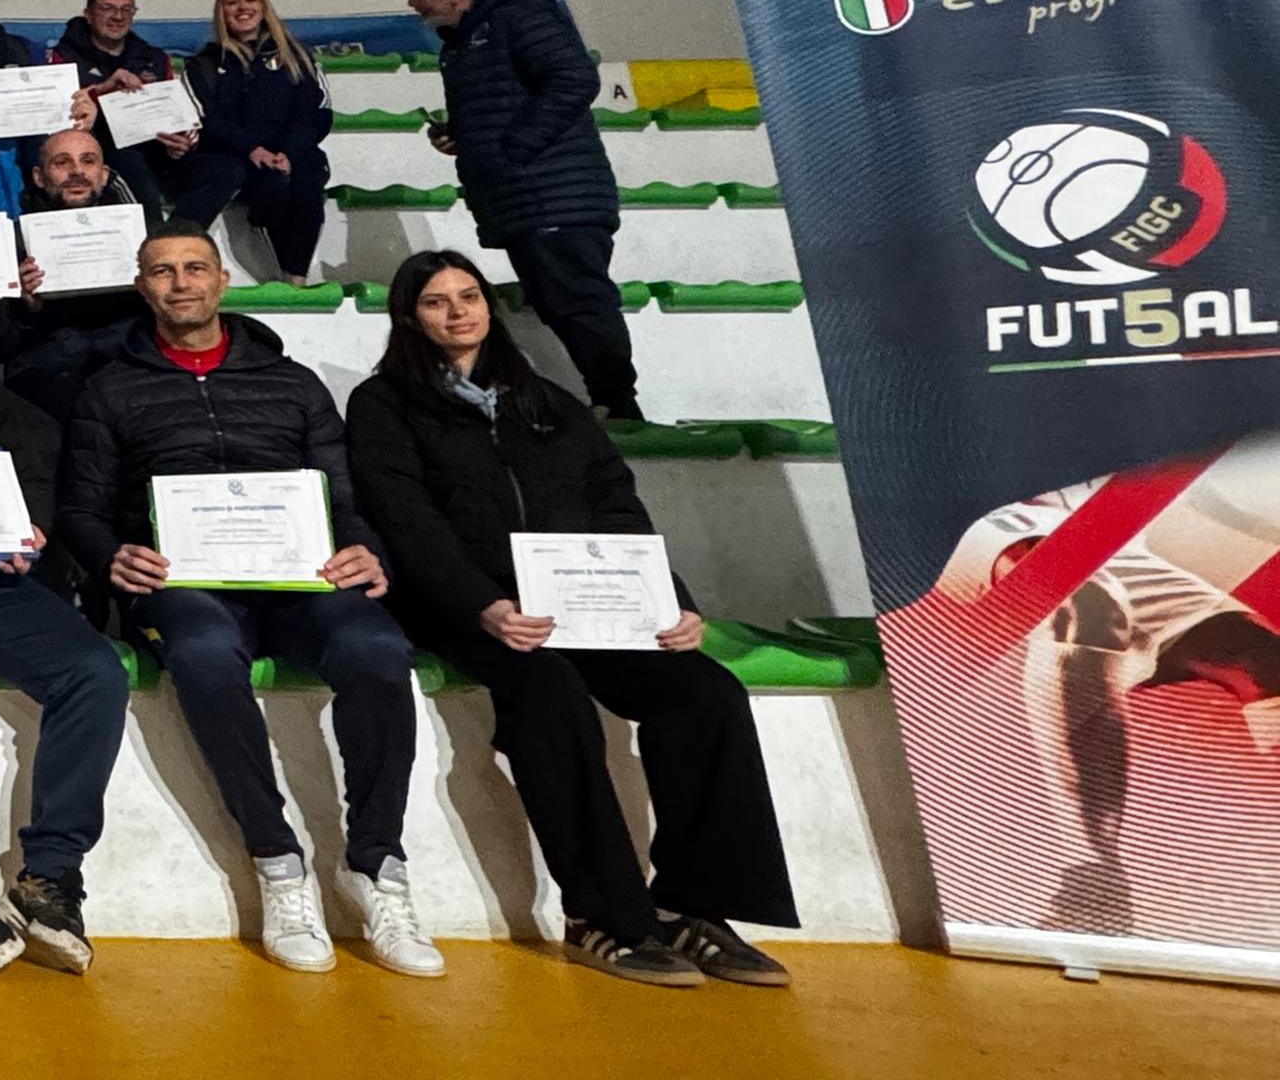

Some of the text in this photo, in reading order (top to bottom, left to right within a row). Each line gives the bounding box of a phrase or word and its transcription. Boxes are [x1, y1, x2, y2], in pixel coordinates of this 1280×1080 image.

[613, 84, 628, 99] A
[1111, 195, 1183, 252] FIGC
[986, 288, 1278, 352] FUT5AL
